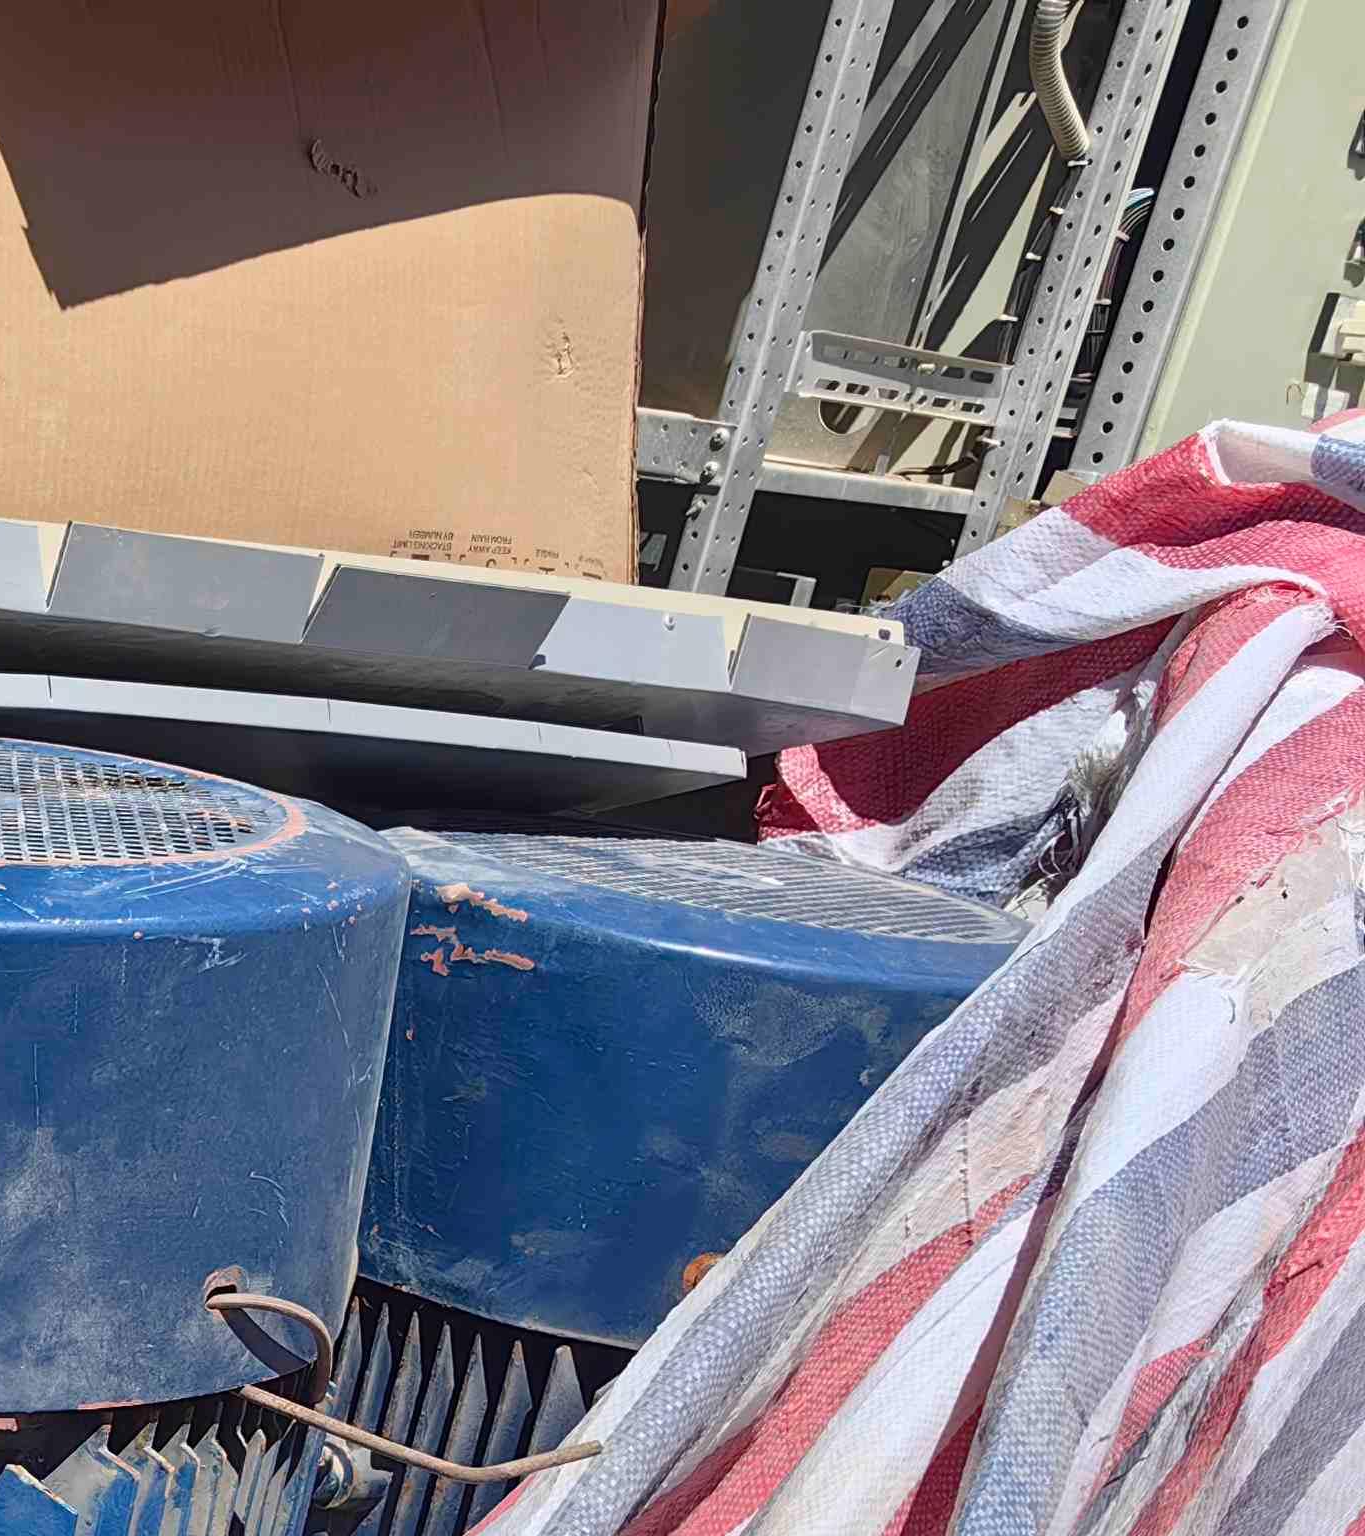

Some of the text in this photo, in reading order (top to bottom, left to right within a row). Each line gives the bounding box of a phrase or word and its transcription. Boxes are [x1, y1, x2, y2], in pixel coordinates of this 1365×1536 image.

[409, 530, 443, 540] NUMBER
[470, 534, 512, 544] FROM RAIN
[391, 539, 452, 551] STACKING LIMIT
